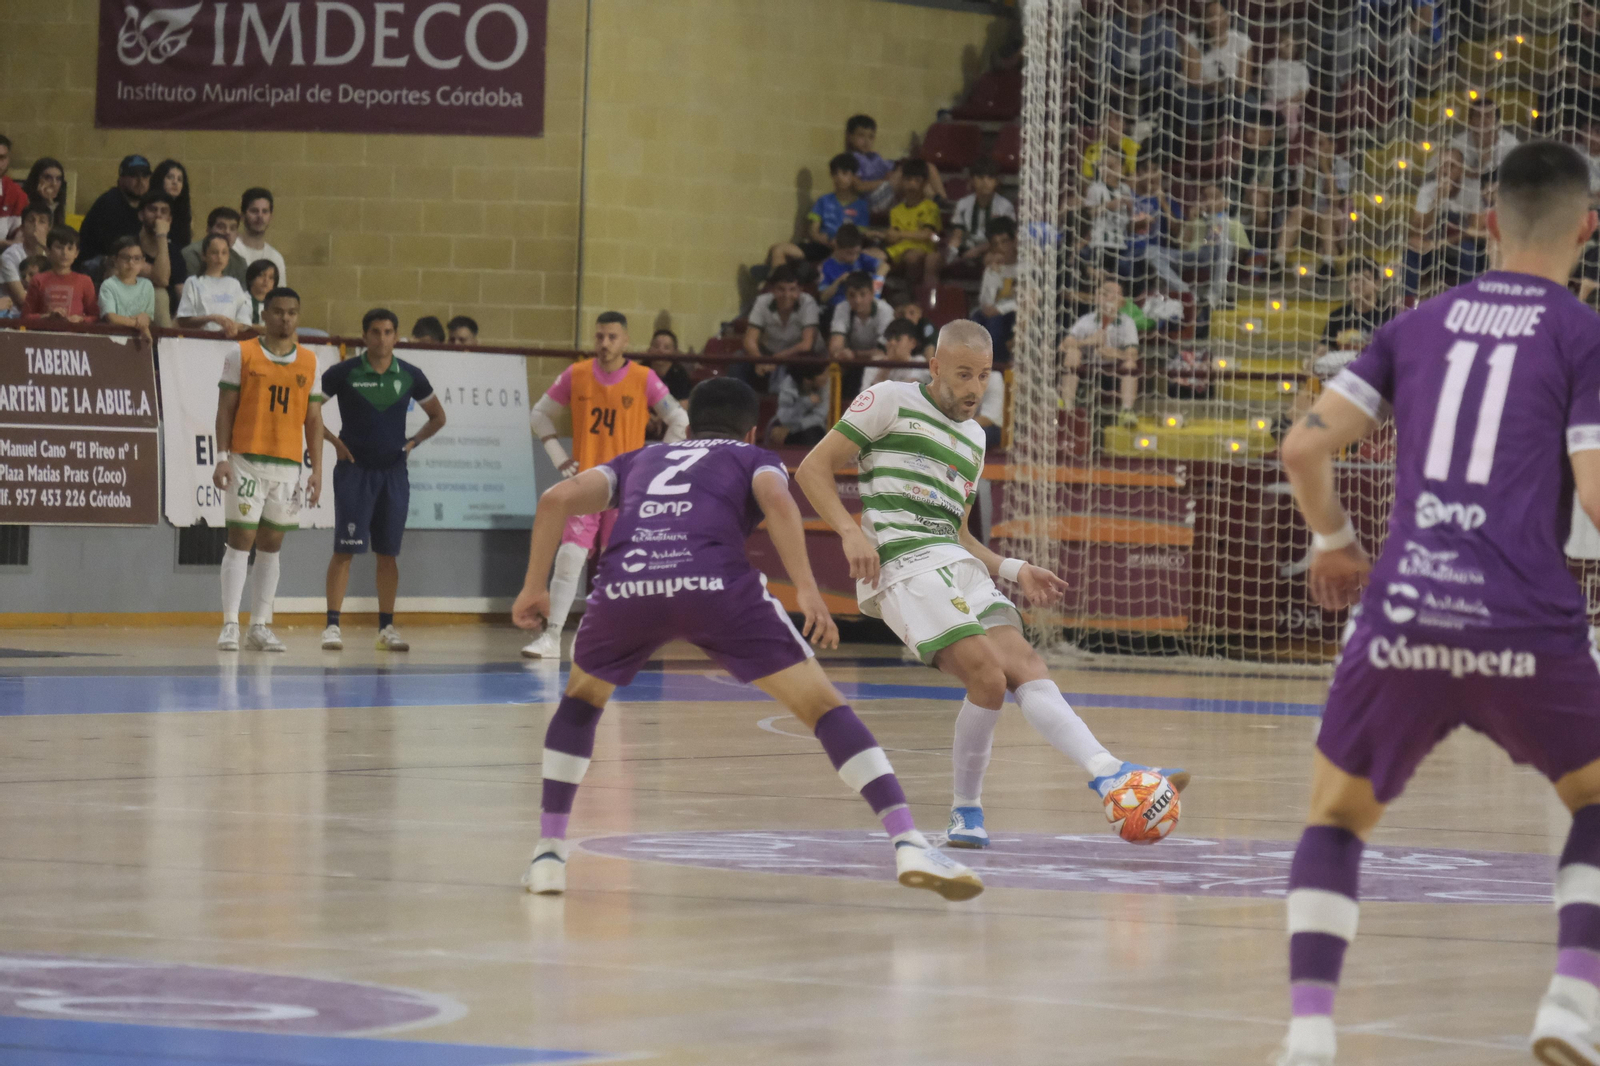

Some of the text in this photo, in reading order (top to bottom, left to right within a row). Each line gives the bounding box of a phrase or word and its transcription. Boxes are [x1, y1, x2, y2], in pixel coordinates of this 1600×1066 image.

[211, 2, 529, 71] IMDECO
[117, 81, 524, 109] Instituto Municipal de Deportes Córdoba
[1444, 298, 1547, 339] QUIQUE
[25, 347, 92, 377] TABERNA
[51, 386, 70, 414] DE
[74, 388, 92, 415] LA
[268, 384, 290, 414] 14
[1423, 340, 1518, 486] 11
[590, 407, 617, 436] 24
[0, 439, 37, 458] Manuel
[40, 440, 66, 459] Cano
[89, 441, 115, 460] Pireo
[133, 443, 139, 461] 1
[0, 464, 24, 482] Plaza
[63, 464, 89, 483] Prats
[92, 465, 127, 487] (Zoco)
[646, 448, 710, 495] 2
[15, 488, 37, 506] 957
[40, 488, 62, 507] 453
[65, 489, 87, 507] 226
[89, 489, 132, 508] Córdoba
[237, 477, 256, 498] 20
